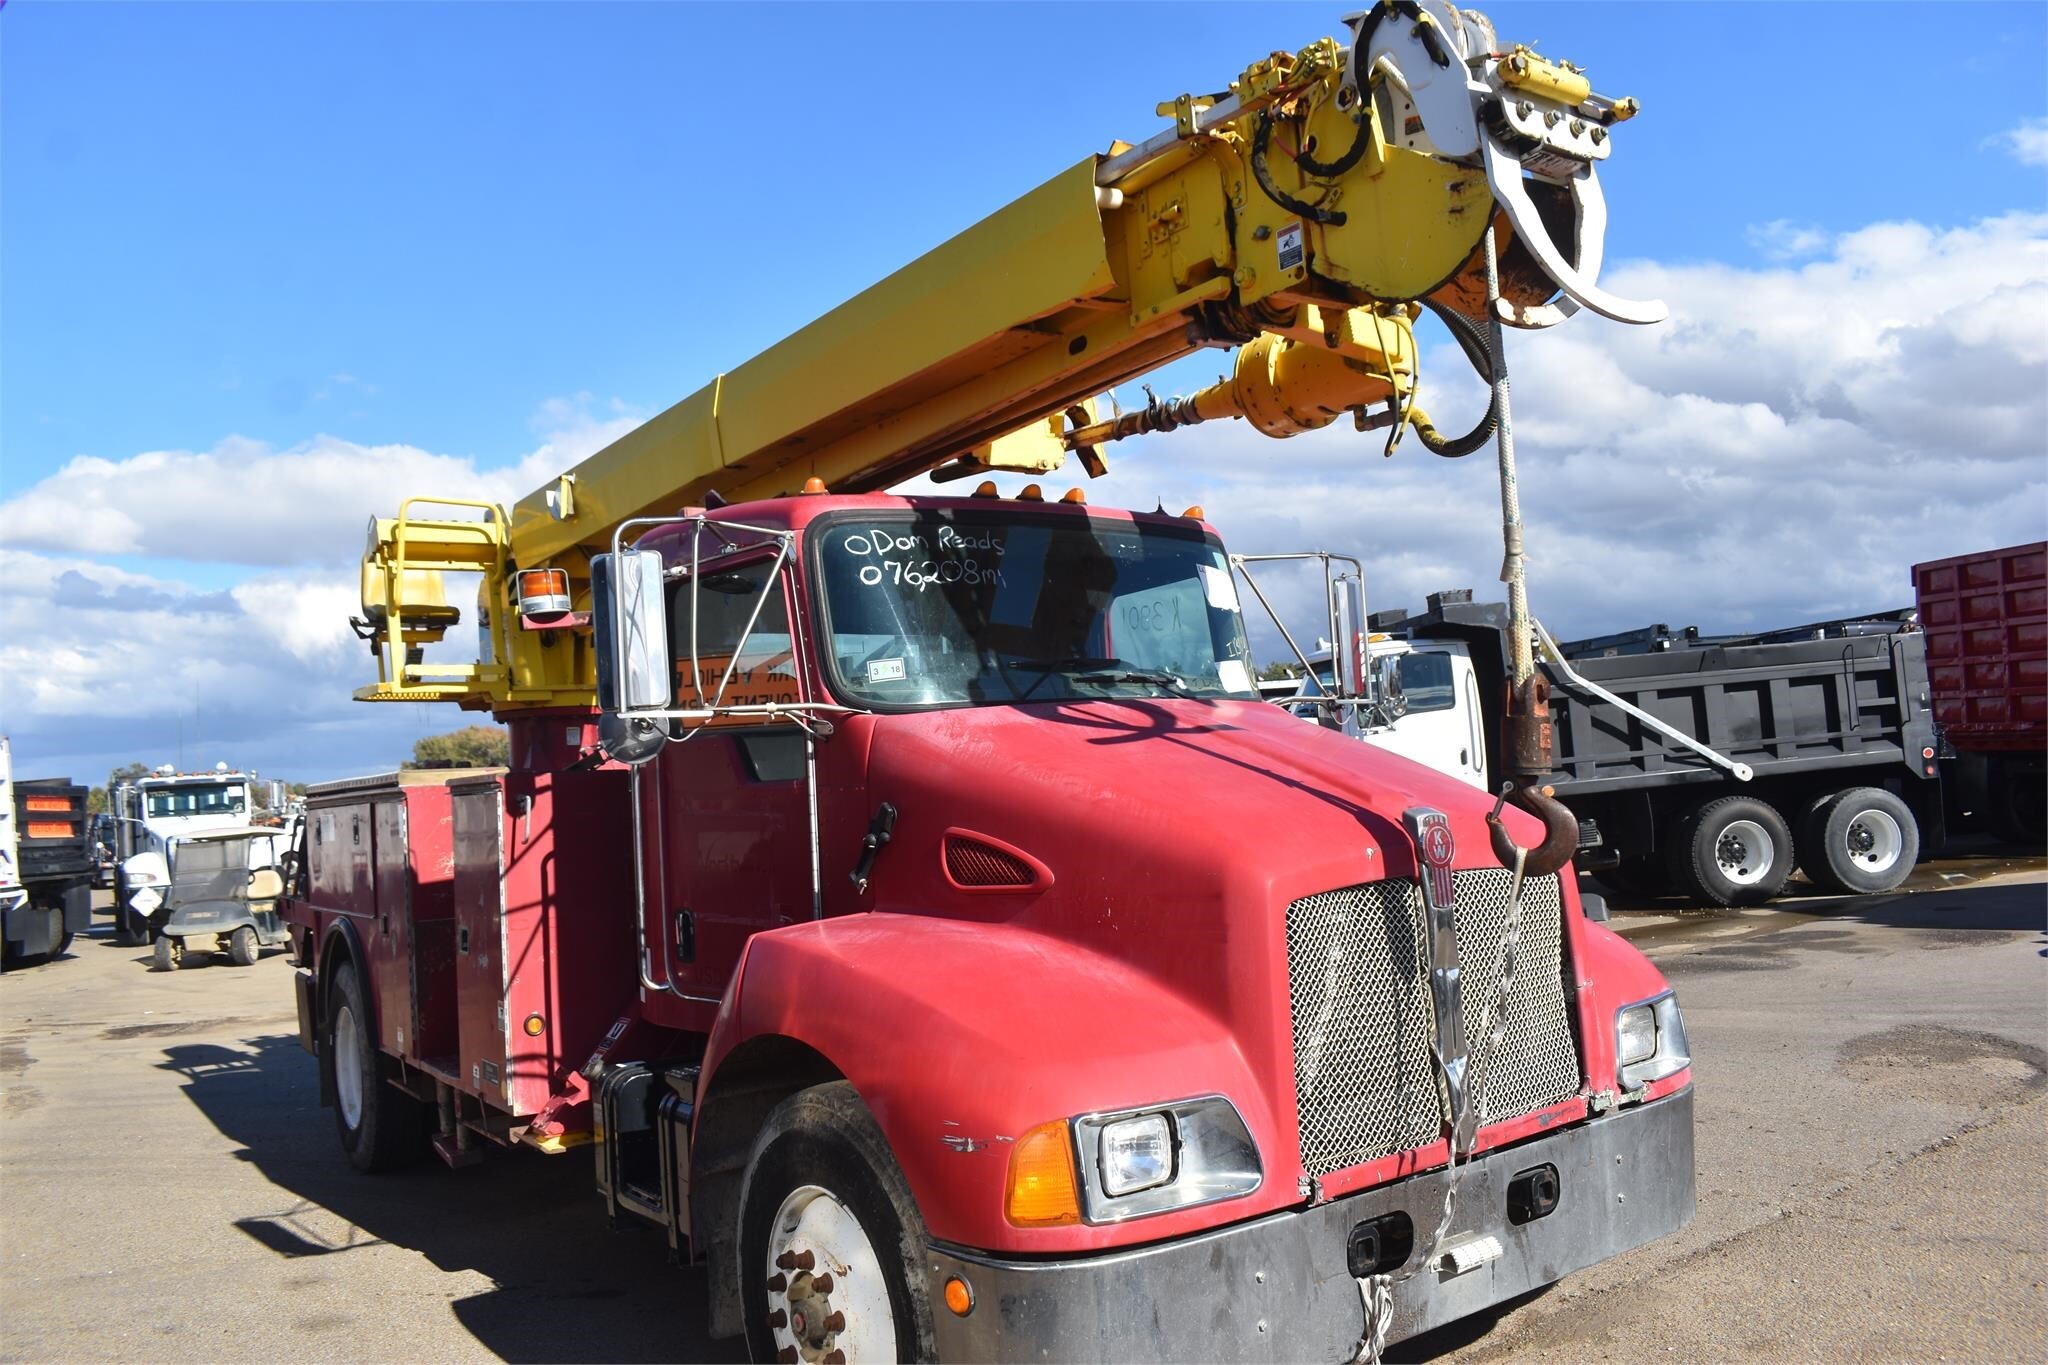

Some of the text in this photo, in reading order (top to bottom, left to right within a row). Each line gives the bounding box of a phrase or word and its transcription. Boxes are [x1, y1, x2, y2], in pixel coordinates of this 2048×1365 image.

[938, 525, 1006, 556] Reads
[873, 665, 901, 676] 3 18
